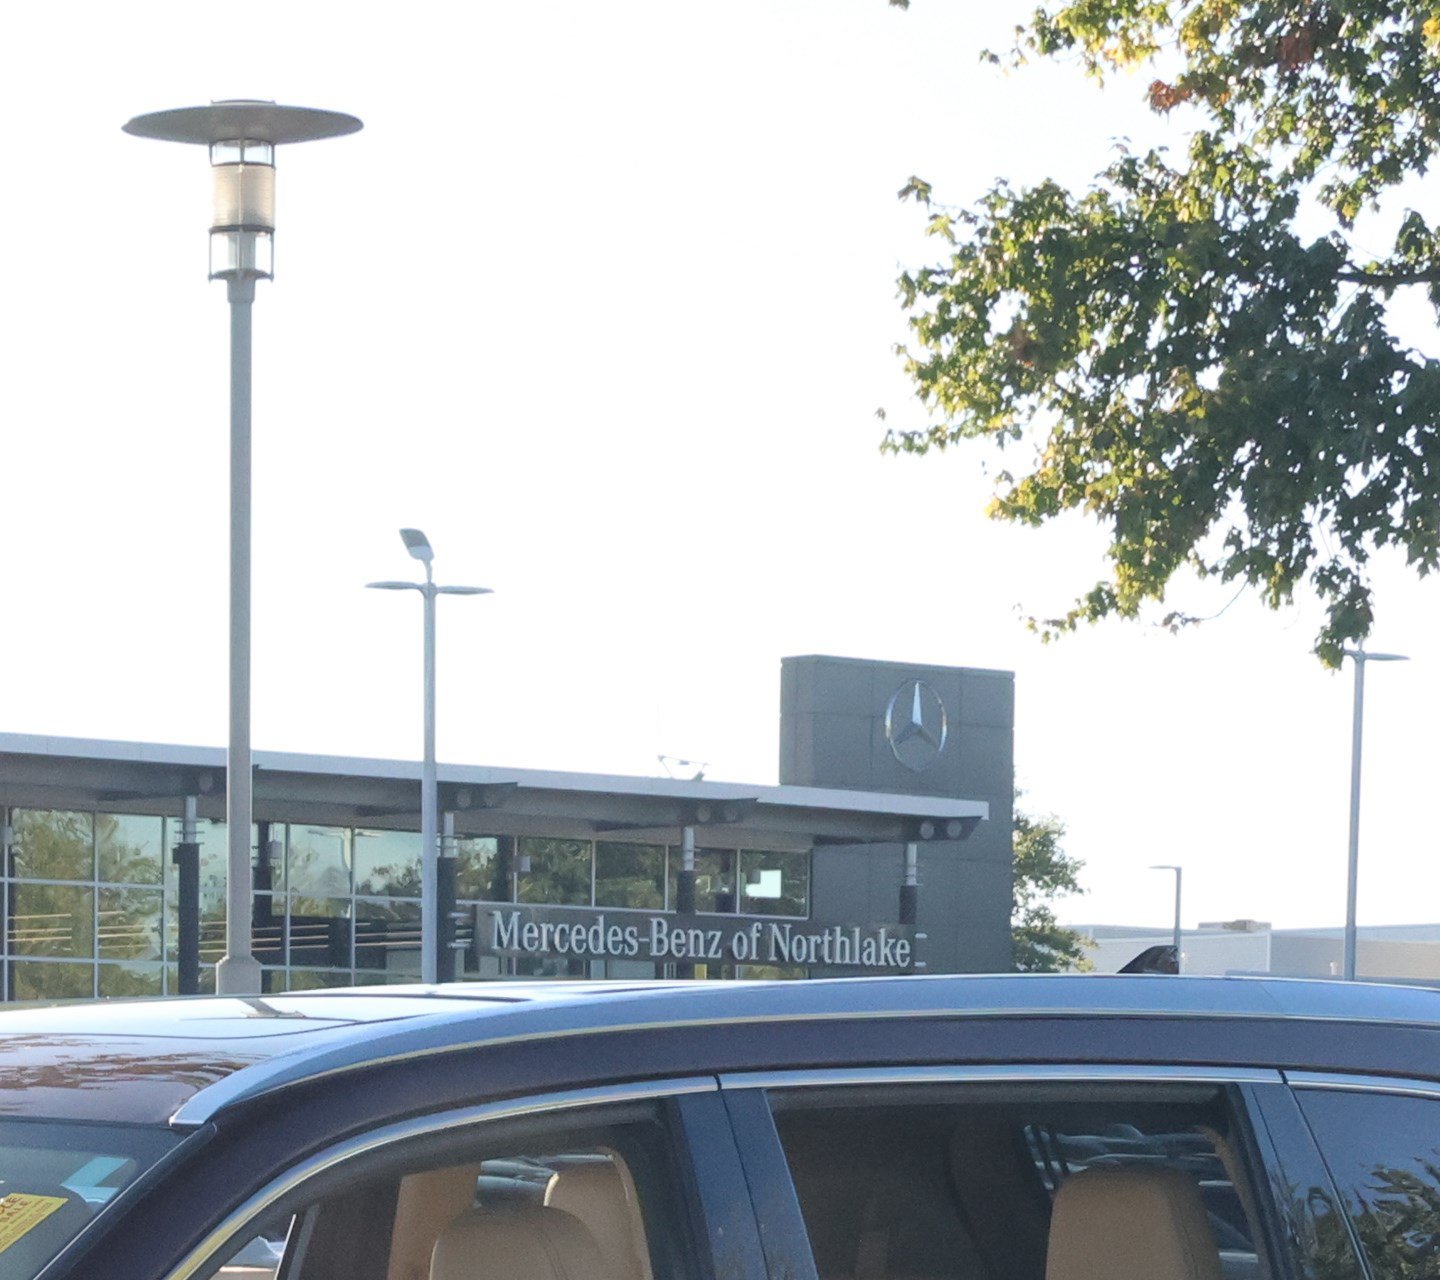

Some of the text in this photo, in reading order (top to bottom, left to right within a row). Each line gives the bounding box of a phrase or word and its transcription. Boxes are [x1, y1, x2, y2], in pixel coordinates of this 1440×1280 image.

[491, 910, 911, 968] Mercedes-Benz of Northlake
